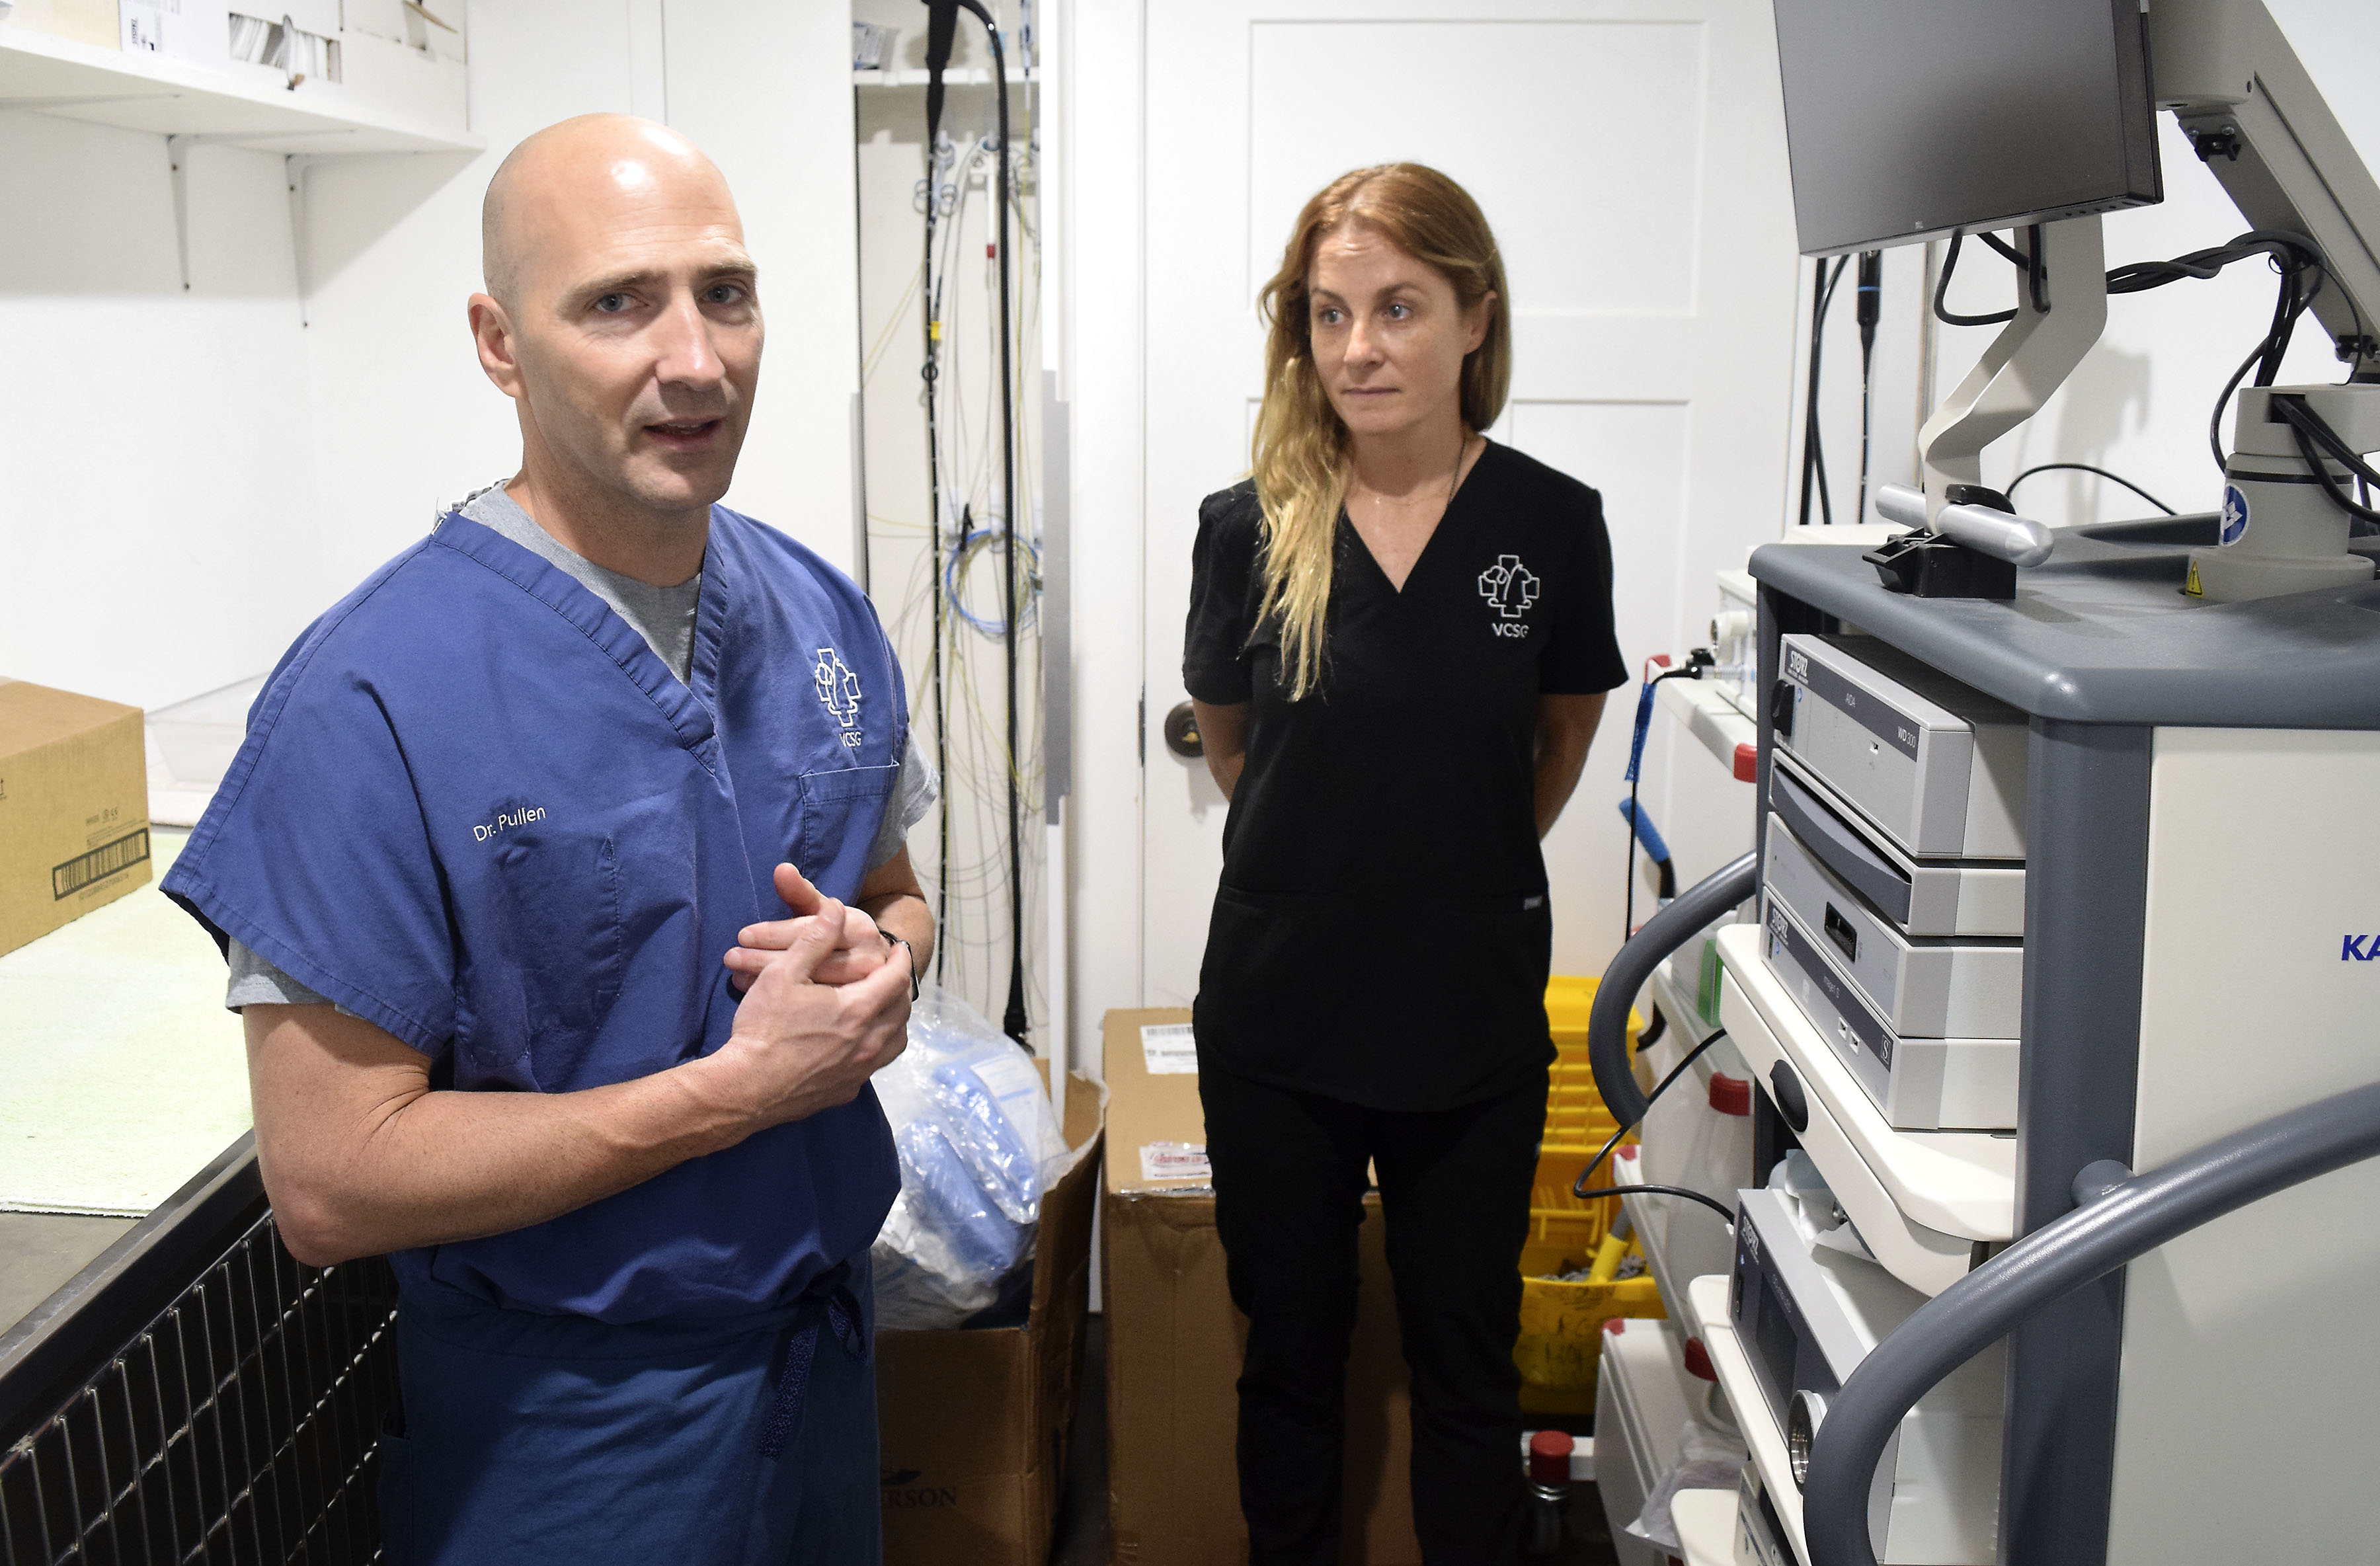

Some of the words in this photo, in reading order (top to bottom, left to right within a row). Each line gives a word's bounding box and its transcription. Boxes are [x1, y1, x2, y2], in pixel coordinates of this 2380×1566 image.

[1491, 623, 1529, 639] VCSG
[1790, 650, 1808, 678] STORZ
[839, 731, 861, 747] VCSG
[1897, 726, 1907, 741] WD
[1907, 732, 1917, 748] 300
[473, 825, 496, 842] Dr.
[498, 807, 546, 831] Pullen
[1772, 908, 1788, 939] STORZ
